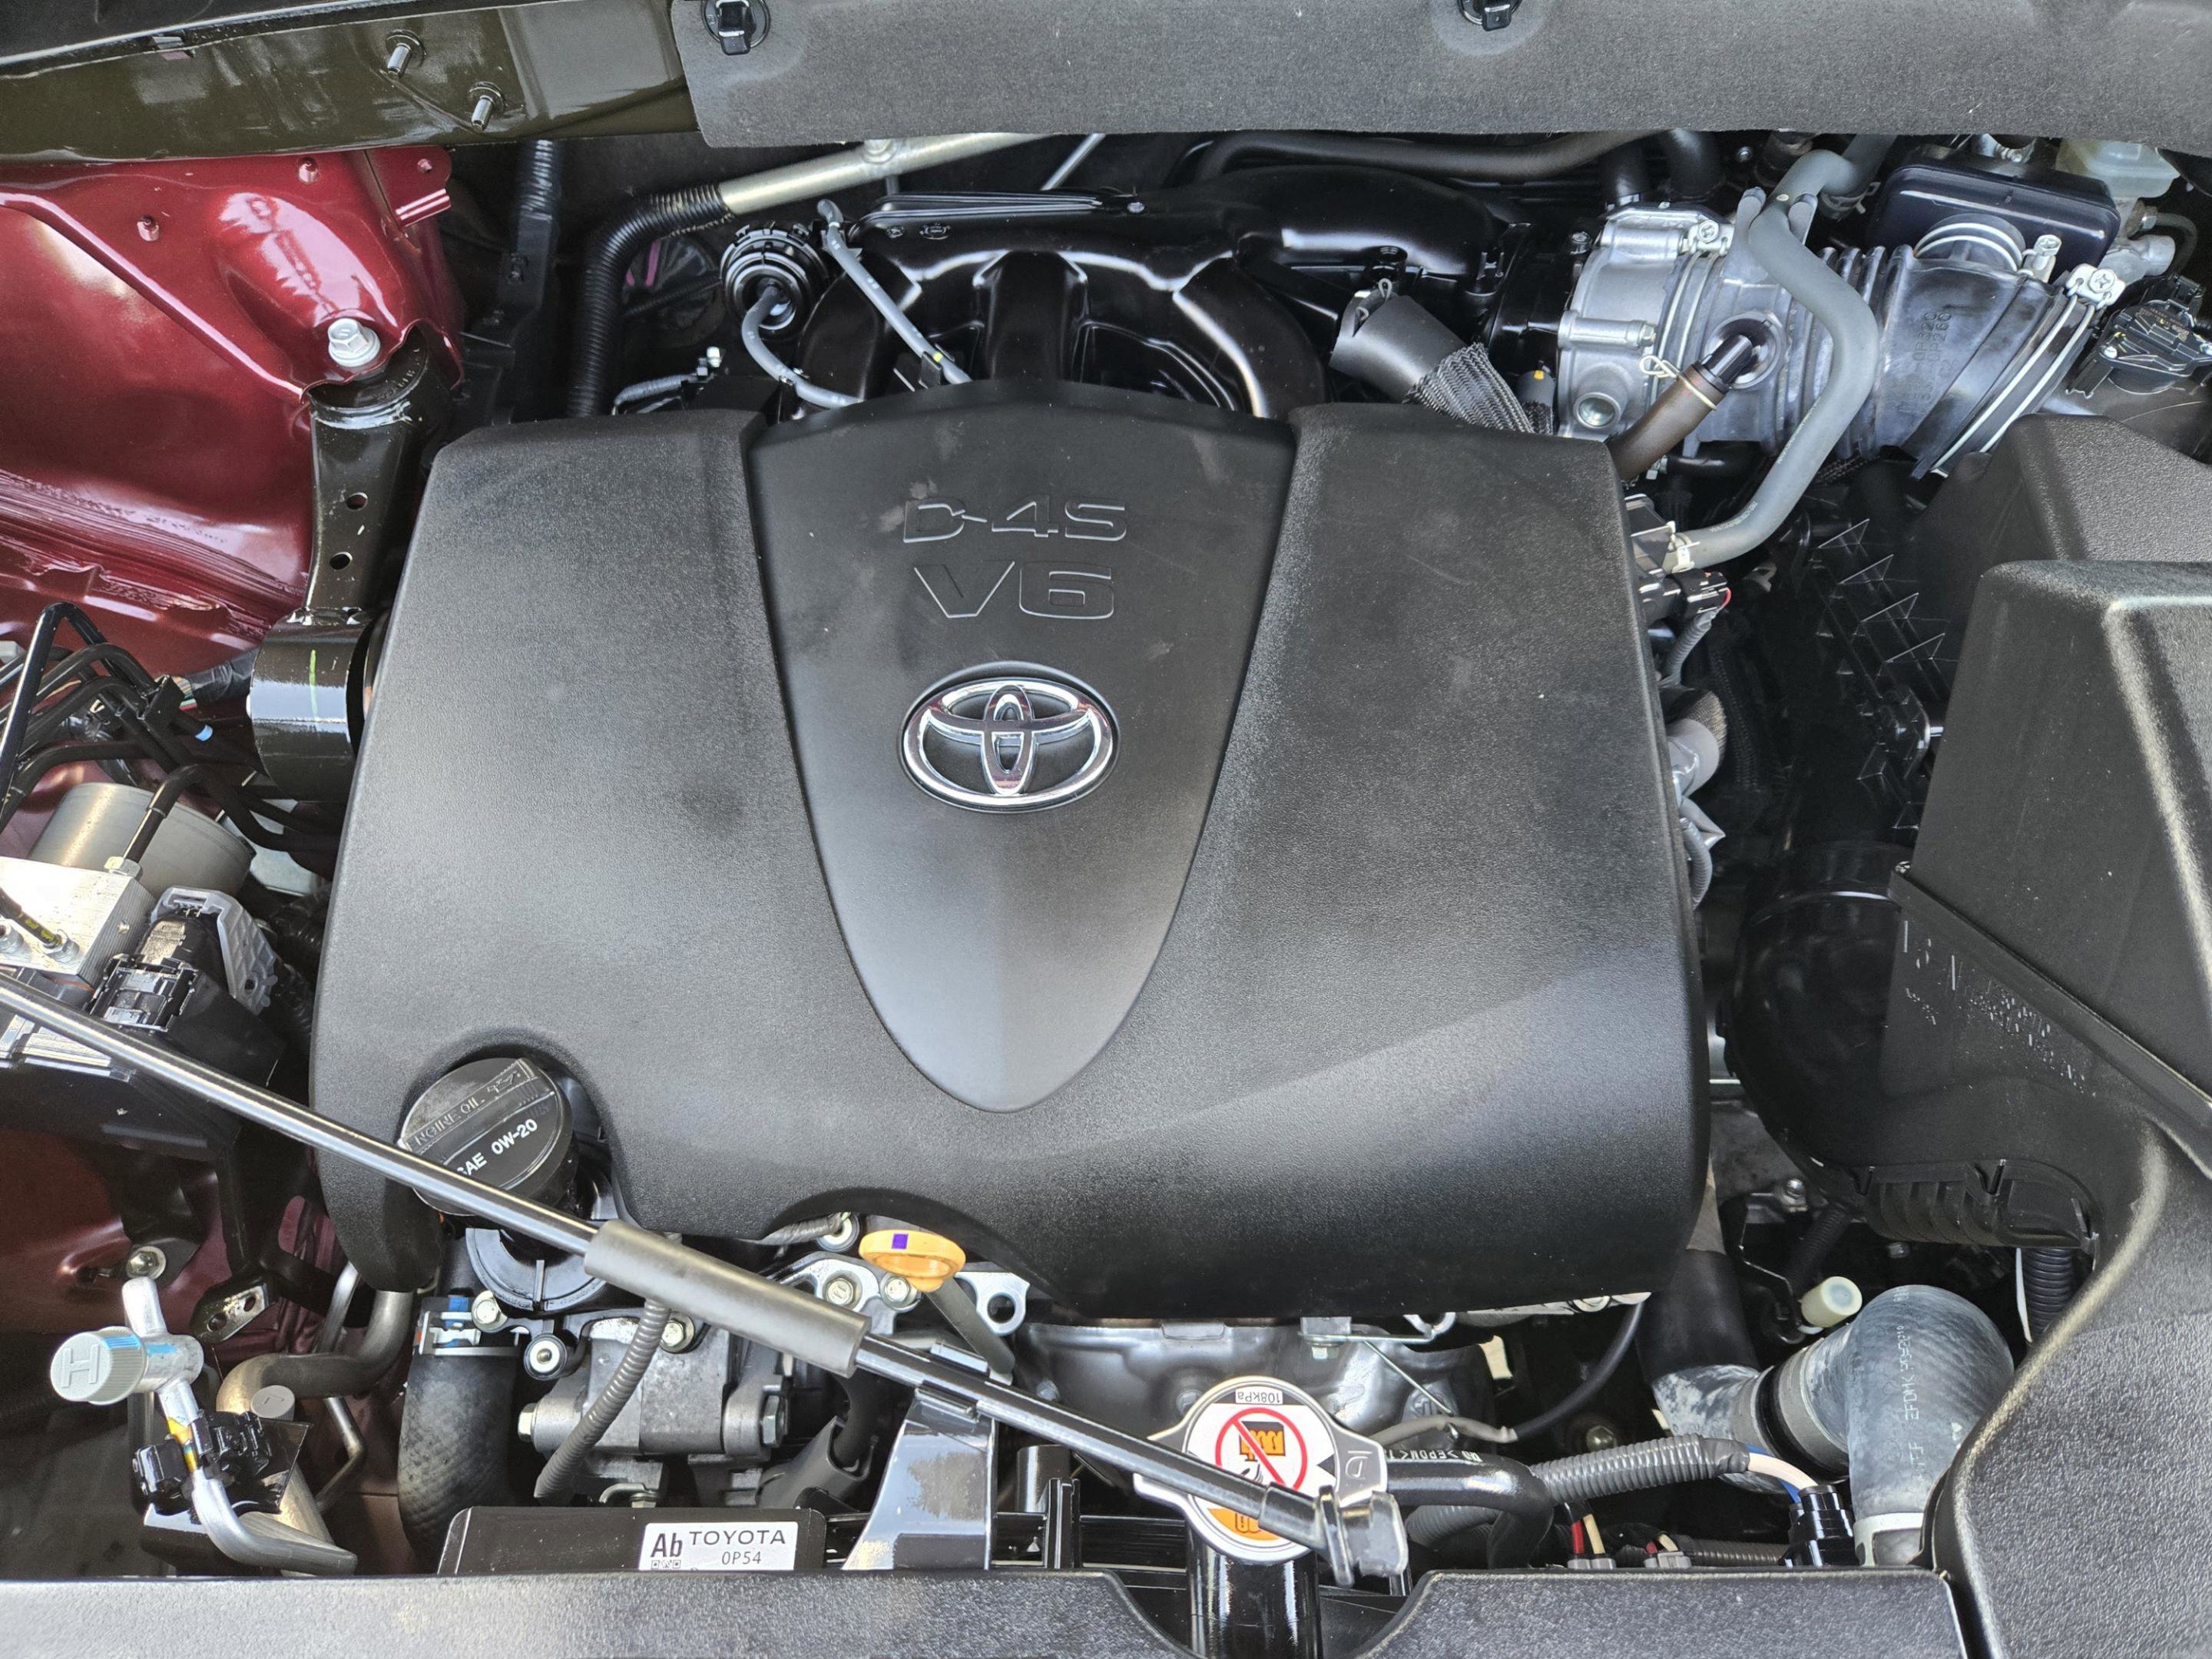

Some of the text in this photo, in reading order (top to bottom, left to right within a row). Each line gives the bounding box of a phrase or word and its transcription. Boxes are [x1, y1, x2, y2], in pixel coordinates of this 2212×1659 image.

[903, 498, 1127, 542] D-4S
[913, 561, 1114, 619] V6
[410, 1096, 486, 1147] NGINE OIL
[491, 1118, 538, 1155] 0W-20
[61, 1344, 101, 1389] H
[1237, 1391, 1281, 1403] 108kPa
[651, 1532, 684, 1558] Ab
[689, 1529, 786, 1545] TOYOTA
[721, 1551, 762, 1565] 0P54
